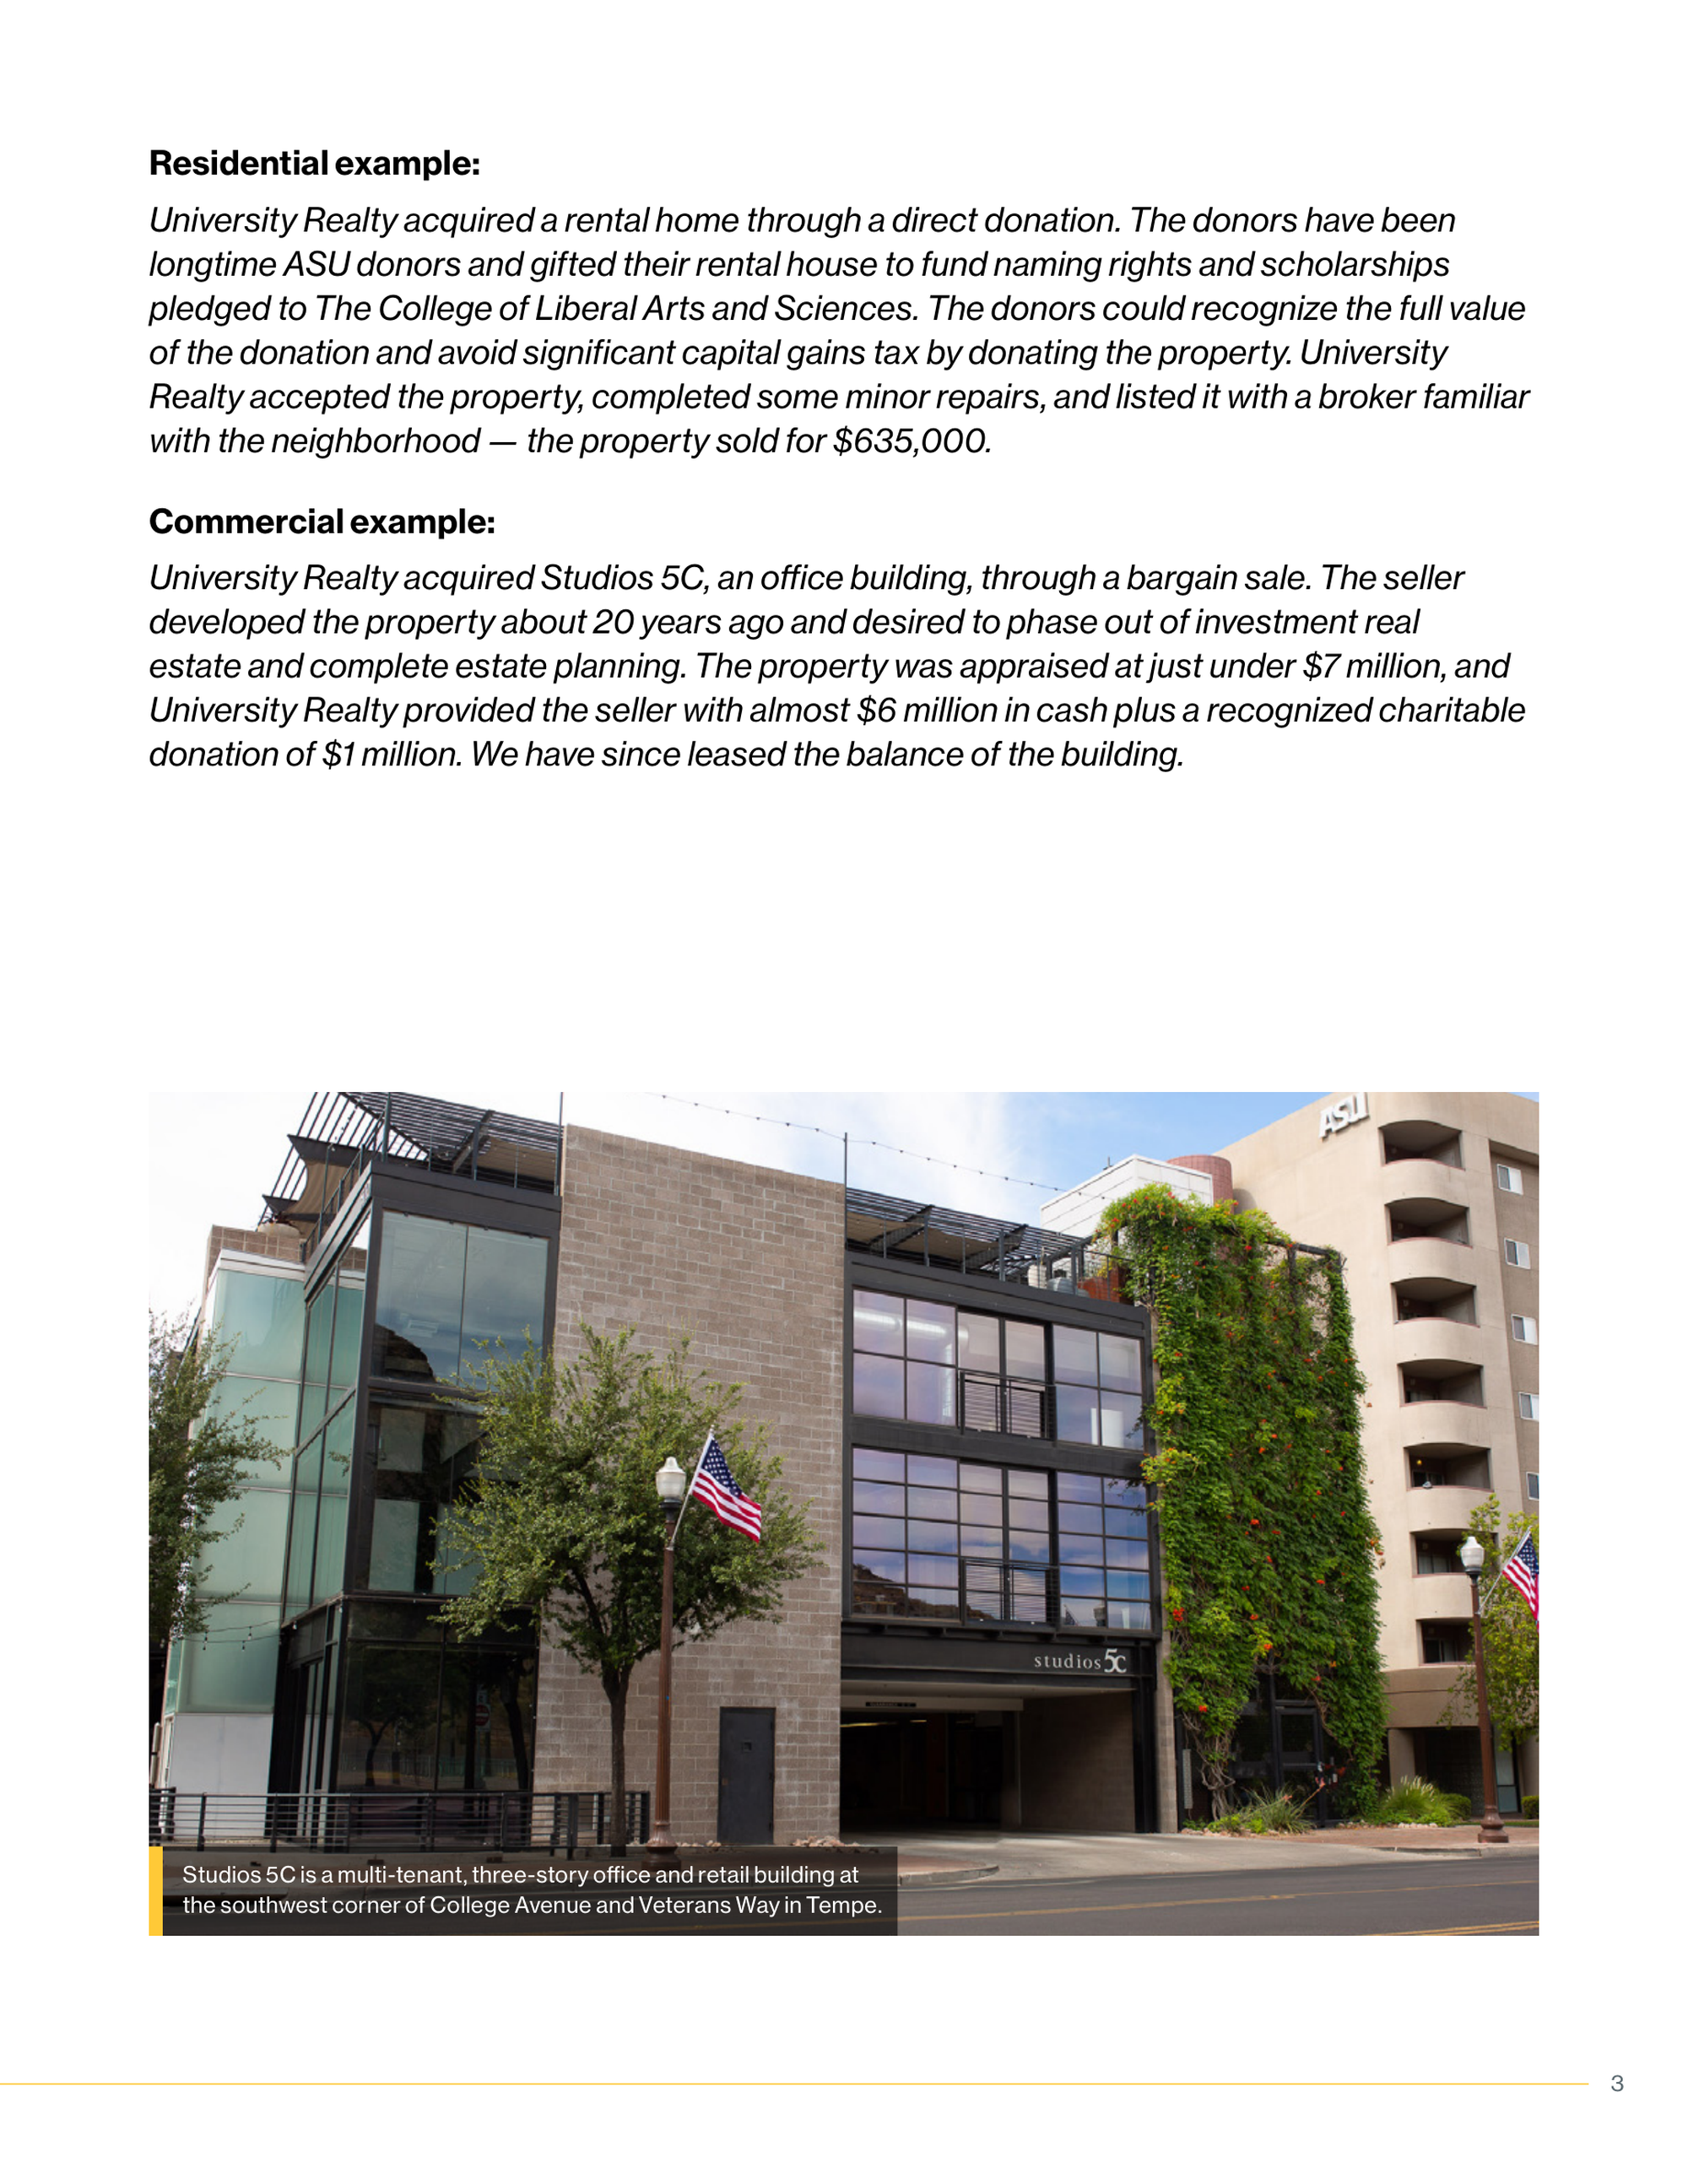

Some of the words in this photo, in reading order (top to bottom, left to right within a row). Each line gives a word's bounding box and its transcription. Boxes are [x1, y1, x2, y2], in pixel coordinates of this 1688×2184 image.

[150, 149, 328, 176] Residential
[334, 149, 480, 181] example:
[150, 206, 299, 239] University
[303, 206, 400, 239] Realty
[403, 206, 537, 239] acquired
[540, 213, 558, 233] a
[564, 206, 651, 233] rental
[655, 206, 739, 233] home
[747, 206, 862, 239] through
[868, 213, 885, 233] a
[892, 206, 979, 233] direct
[984, 206, 1121, 233] donation.
[1131, 206, 1187, 233] The
[1193, 206, 1298, 233] donors
[1304, 206, 1375, 233] have
[1381, 206, 1456, 233] been
[148, 295, 273, 327] pledged
[279, 295, 307, 322] to
[316, 295, 371, 322] The
[379, 294, 493, 327] College
[499, 294, 532, 322] of
[535, 295, 639, 322] Liberal
[641, 295, 706, 322] Arts
[711, 295, 770, 322] and
[774, 294, 918, 322] Sciences.
[929, 295, 985, 322] The
[991, 295, 1096, 322] donors
[1102, 295, 1187, 322] could
[1191, 295, 1338, 327] recognize
[1346, 295, 1393, 322] the
[1399, 294, 1444, 322] full
[1450, 295, 1526, 322] value
[149, 338, 182, 365] of
[187, 338, 234, 365] the
[240, 338, 370, 365] donation
[376, 338, 434, 365] and
[437, 338, 518, 365] avoid
[522, 338, 677, 371] significant
[682, 338, 782, 371] capital
[786, 338, 866, 371] gains
[874, 339, 921, 365] tax
[926, 338, 965, 371] by
[968, 338, 1099, 371] donating
[1106, 338, 1152, 365] the
[1157, 339, 1291, 371] property.
[1301, 338, 1450, 371] University
[149, 382, 246, 415] Realty
[249, 382, 392, 415] accepted
[398, 382, 444, 410] the
[449, 384, 584, 415] property,
[592, 382, 752, 415] completed
[756, 389, 839, 410] some
[845, 382, 932, 409] minor
[936, 382, 1046, 415] repairs,
[1053, 382, 1112, 409] and
[1115, 382, 1198, 410] listed
[1202, 382, 1222, 409] it
[1228, 382, 1288, 409] with
[1294, 389, 1312, 409] a
[1318, 382, 1418, 410] broker
[1423, 382, 1532, 409] familiar
[149, 507, 344, 535] Commercial
[349, 507, 495, 540] example:
[150, 564, 299, 597] University
[303, 564, 400, 597] Realty
[403, 564, 537, 597] acquired
[540, 563, 654, 591] Studios
[660, 563, 710, 595] 5C,
[717, 570, 754, 591] an
[760, 564, 844, 591] office
[850, 564, 972, 597] building,
[982, 564, 1096, 597] through
[1102, 570, 1120, 591] a
[1126, 564, 1238, 597] bargain
[1244, 564, 1312, 591] sale.
[1322, 564, 1377, 591] The
[1382, 564, 1466, 591] seller
[149, 608, 306, 641] developed
[312, 608, 360, 635] the
[364, 608, 497, 641] property
[500, 608, 588, 635] about
[592, 608, 635, 635] 20
[638, 614, 722, 641] years
[728, 614, 784, 641] ago
[790, 608, 848, 635] and
[852, 608, 966, 635] desired
[972, 608, 1001, 635] to
[1005, 608, 1098, 641] phase
[1104, 608, 1154, 635] out
[1160, 608, 1193, 635] of
[1195, 608, 1359, 635] investment
[1364, 608, 1421, 635] real
[149, 653, 241, 679] estate
[247, 651, 306, 679] and
[309, 651, 449, 684] complete
[455, 653, 547, 679] estate
[553, 651, 686, 684] planning.
[696, 651, 752, 679] The
[757, 653, 890, 684] property
[895, 658, 954, 679] was
[959, 651, 1110, 684] appraised
[1114, 653, 1144, 678] at
[1145, 651, 1204, 684] just
[1209, 651, 1298, 679] under
[1302, 650, 1343, 682] $7
[1345, 651, 1447, 684] million,
[1454, 651, 1512, 679] and
[150, 696, 299, 729] University
[303, 696, 400, 729] Realty
[402, 696, 537, 729] provided
[542, 696, 588, 723] the
[594, 696, 678, 723] seller
[684, 696, 744, 722] with
[749, 696, 852, 723] almost
[857, 695, 897, 727] $6
[903, 696, 998, 723] million
[1004, 696, 1031, 722] in
[1036, 696, 1108, 723] cash
[1112, 696, 1176, 729] plus
[1182, 702, 1199, 723] a
[1206, 696, 1375, 729] recognized
[1378, 696, 1526, 723] charitable
[1318, 1092, 1369, 1139] ASU
[1034, 1653, 1101, 1669] studios
[1611, 2074, 1624, 2092] 3
